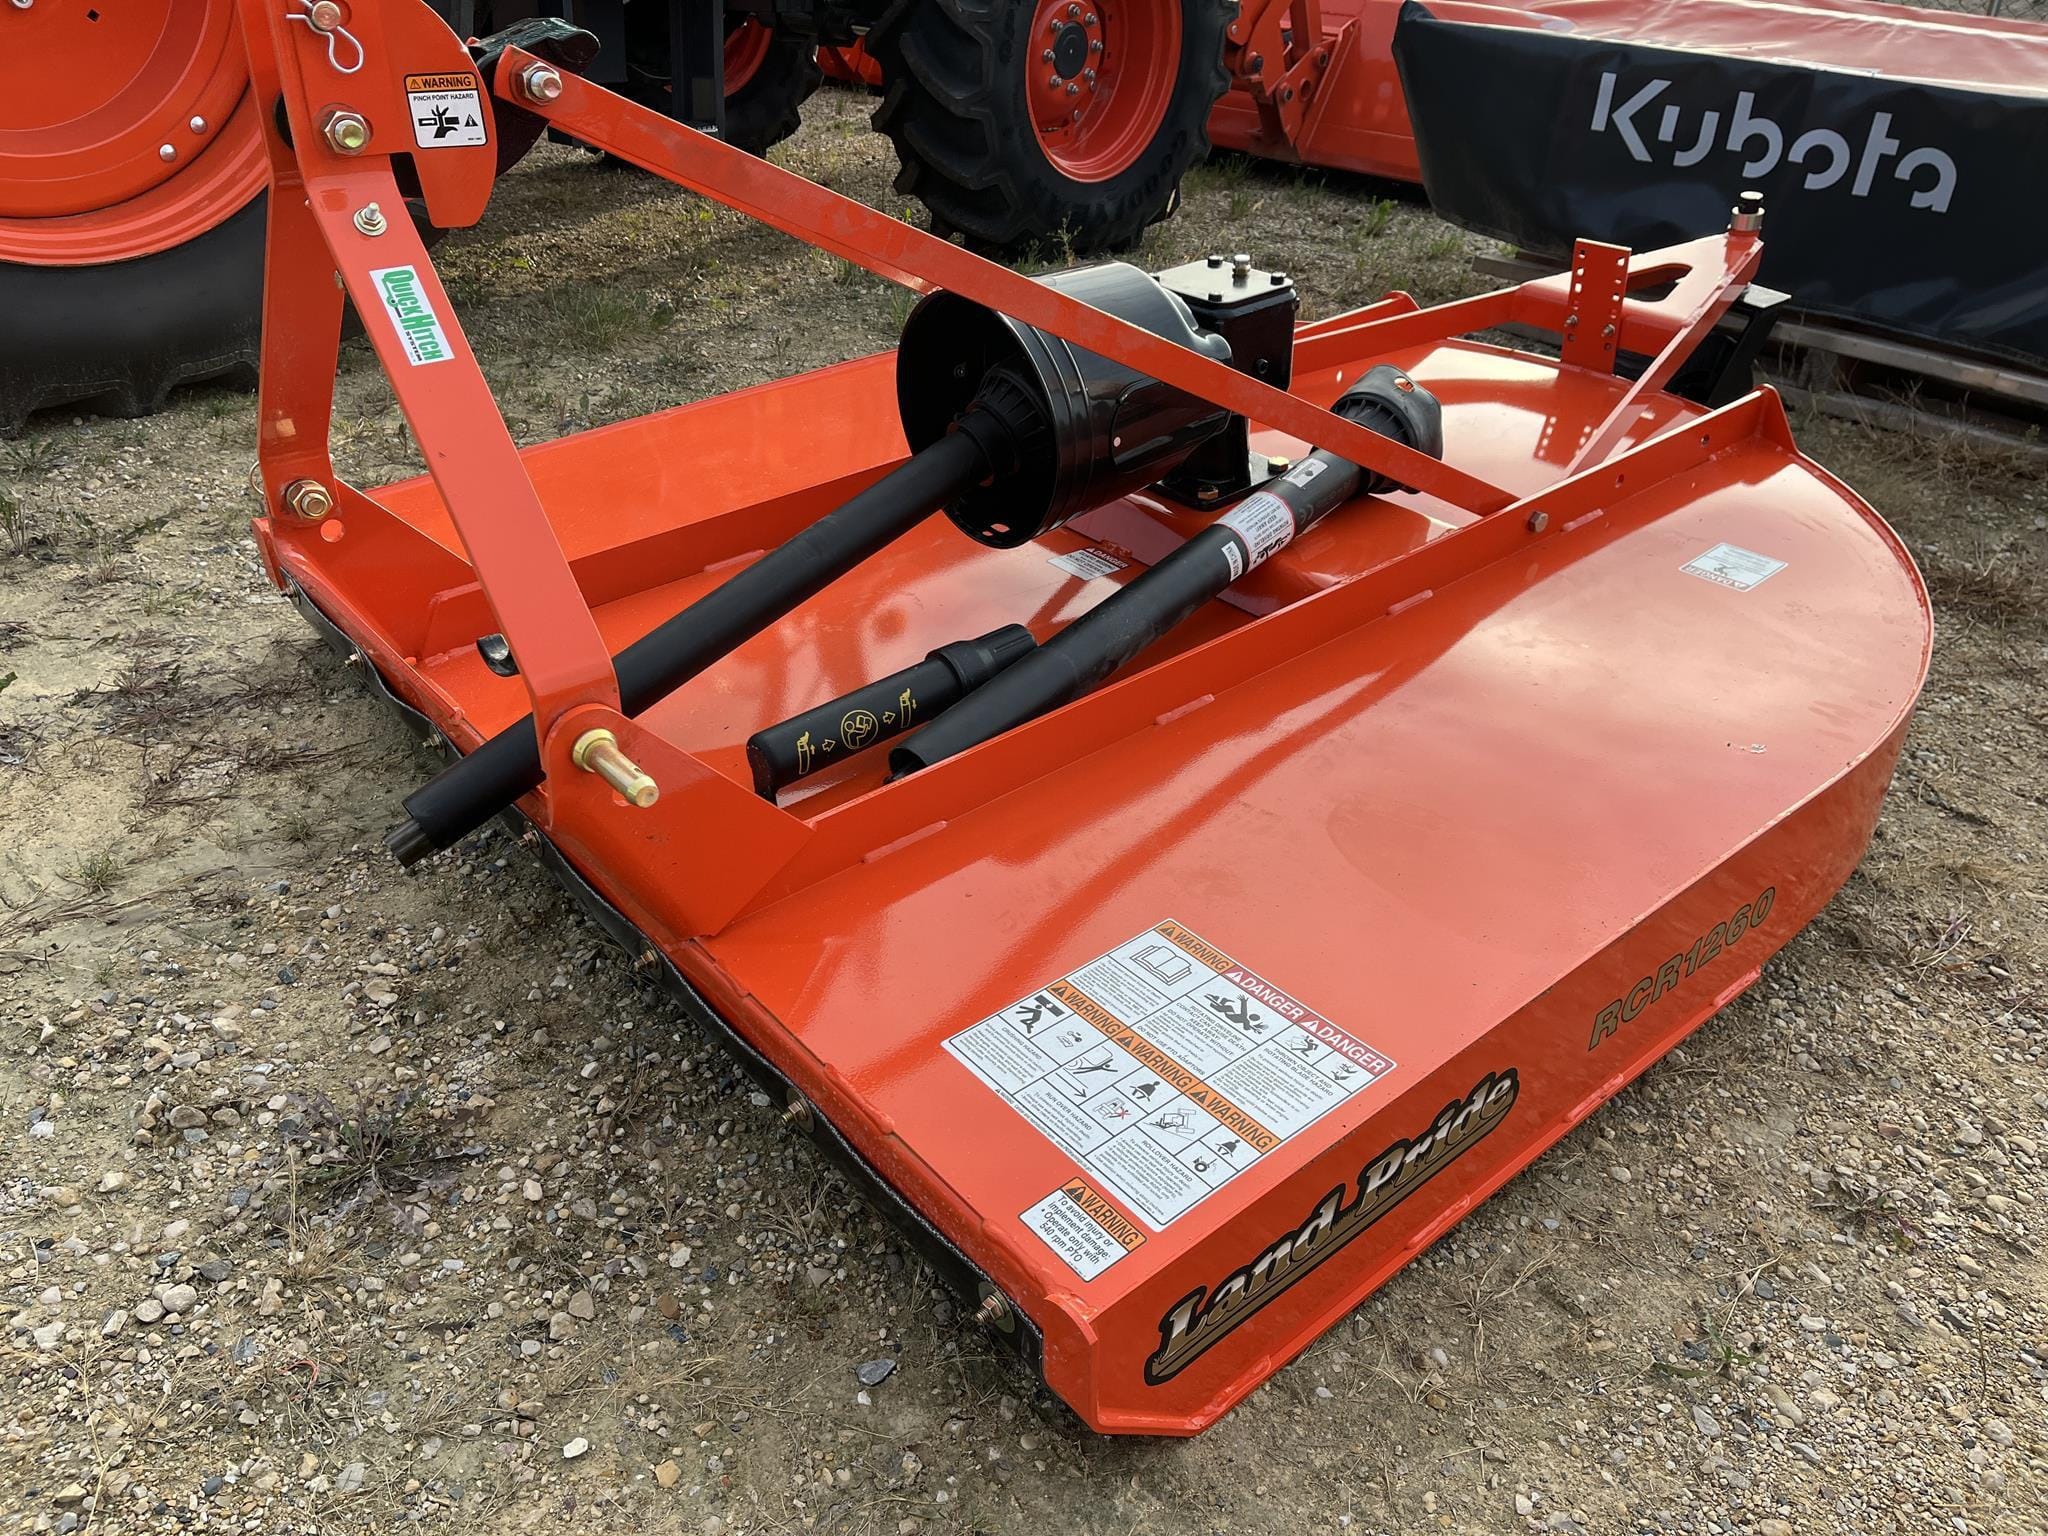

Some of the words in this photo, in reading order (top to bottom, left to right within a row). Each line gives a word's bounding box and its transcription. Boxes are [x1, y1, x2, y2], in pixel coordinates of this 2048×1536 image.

[421, 76, 472, 88] WARNING
[1591, 72, 1957, 213] Kubota
[1094, 550, 1129, 569] DANGER
[1686, 566, 1734, 585] DANGER
[1172, 931, 1230, 971] WARNING
[1588, 886, 1776, 1052] RCR1260
[1064, 991, 1121, 1035] WARNING
[1189, 1005, 1216, 1025] ROTATING
[1239, 977, 1305, 1020] DANGER
[1001, 1027, 1025, 1046] CRUSHING
[1022, 1044, 1042, 1060] HAZARD
[1137, 1025, 1147, 1033] DO
[1145, 1031, 1157, 1040] NOT
[1155, 1038, 1168, 1048] USE
[1165, 1046, 1178, 1056] PTO
[1175, 1002, 1201, 1019] CONTACT
[1199, 1018, 1212, 1028] CAN
[1210, 1026, 1229, 1040] CAUSE
[1227, 1038, 1247, 1052] DEATH
[1175, 1014, 1188, 1023] NOT
[1185, 1022, 1210, 1040] OPERATE
[1189, 1018, 1204, 1028] KEEP
[1130, 1042, 1193, 1089] WARNING
[1273, 1047, 1298, 1066] THROWN
[1296, 1063, 1320, 1080] OBJECT
[1318, 1079, 1333, 1089] AND
[1316, 1026, 1386, 1073] DANGER
[1263, 1047, 1292, 1068] ROTATING
[1290, 1066, 1311, 1081] BLADE
[1309, 1078, 1334, 1097] HAZARD
[1045, 1091, 1058, 1103] RUN
[1055, 1101, 1072, 1114] OVER
[1070, 1112, 1093, 1131] HAZARD
[1205, 1097, 1273, 1150] WARNING
[1141, 1140, 1171, 1165] ROLLOVER
[1169, 1162, 1193, 1182] HAZARD
[1043, 1211, 1071, 1237] Operate
[1068, 1235, 1086, 1251] only
[1083, 1248, 1100, 1265] with
[1047, 1201, 1084, 1235] implement
[1057, 1194, 1069, 1206] To
[1065, 1204, 1088, 1223] avoid
[1083, 1219, 1106, 1241] injury
[1102, 1238, 1114, 1247] or
[1077, 1193, 1139, 1247] WARNING
[1158, 1190, 1344, 1364] Land
[1355, 1076, 1515, 1217] Pride
[1039, 1221, 1056, 1236] 540
[1050, 1234, 1067, 1249] rpm
[1064, 1245, 1083, 1262] PTO
